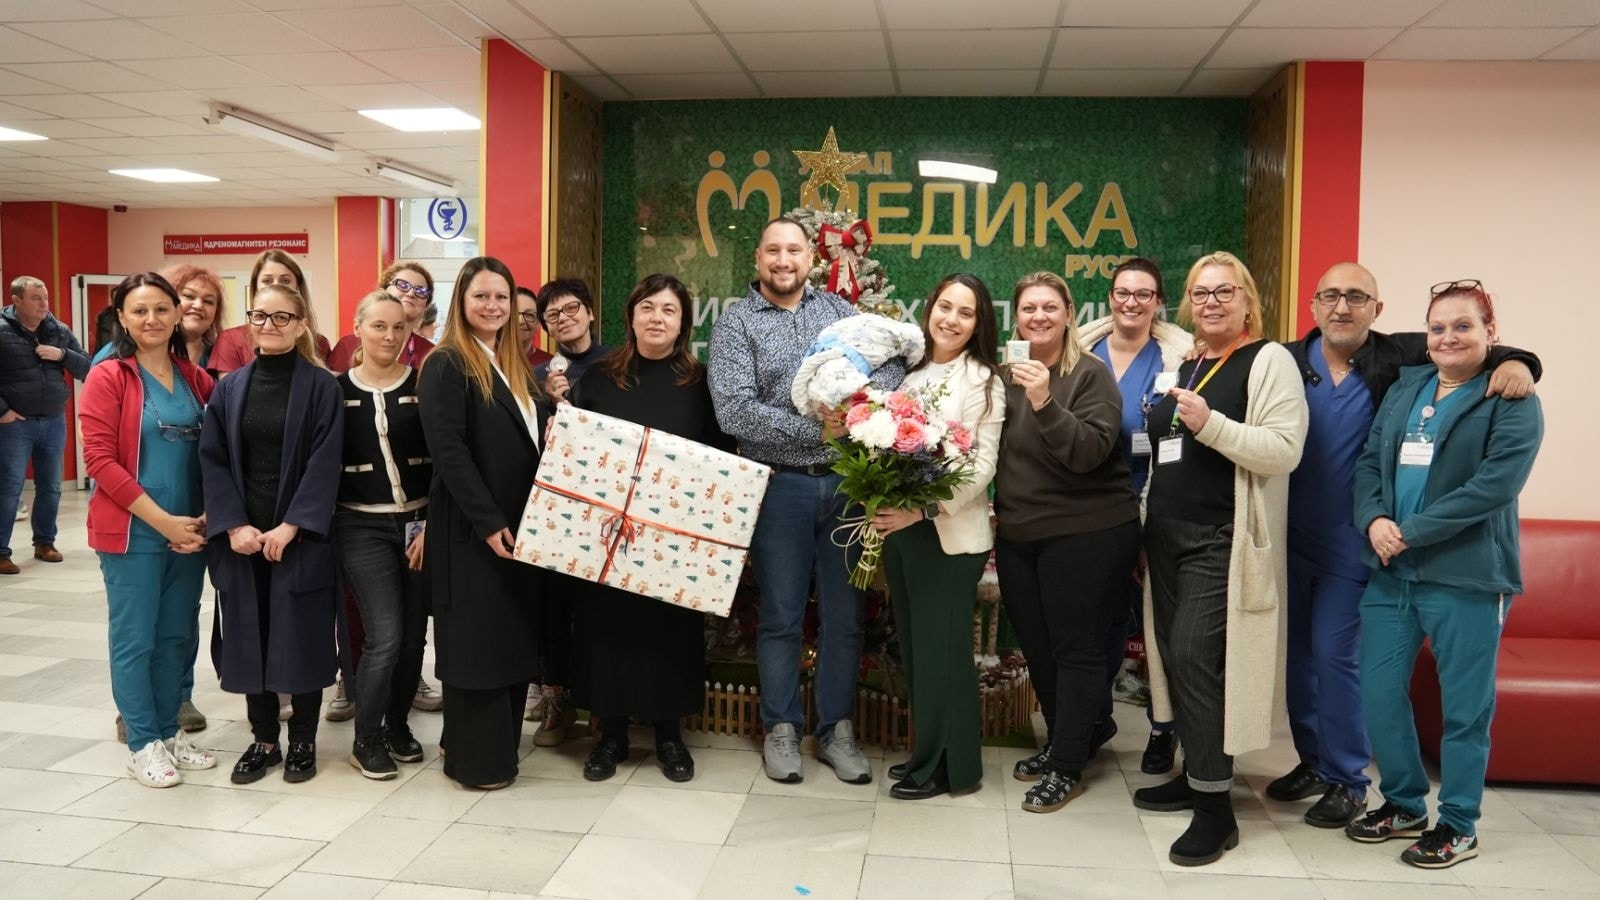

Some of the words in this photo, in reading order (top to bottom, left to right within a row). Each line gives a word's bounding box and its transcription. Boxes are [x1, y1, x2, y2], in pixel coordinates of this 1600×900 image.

[203, 240, 267, 249] ЯДРЕНОМАГНИТЕН
[268, 239, 306, 247] РЕЗОНАНС
[1065, 254, 1138, 279] РУС
